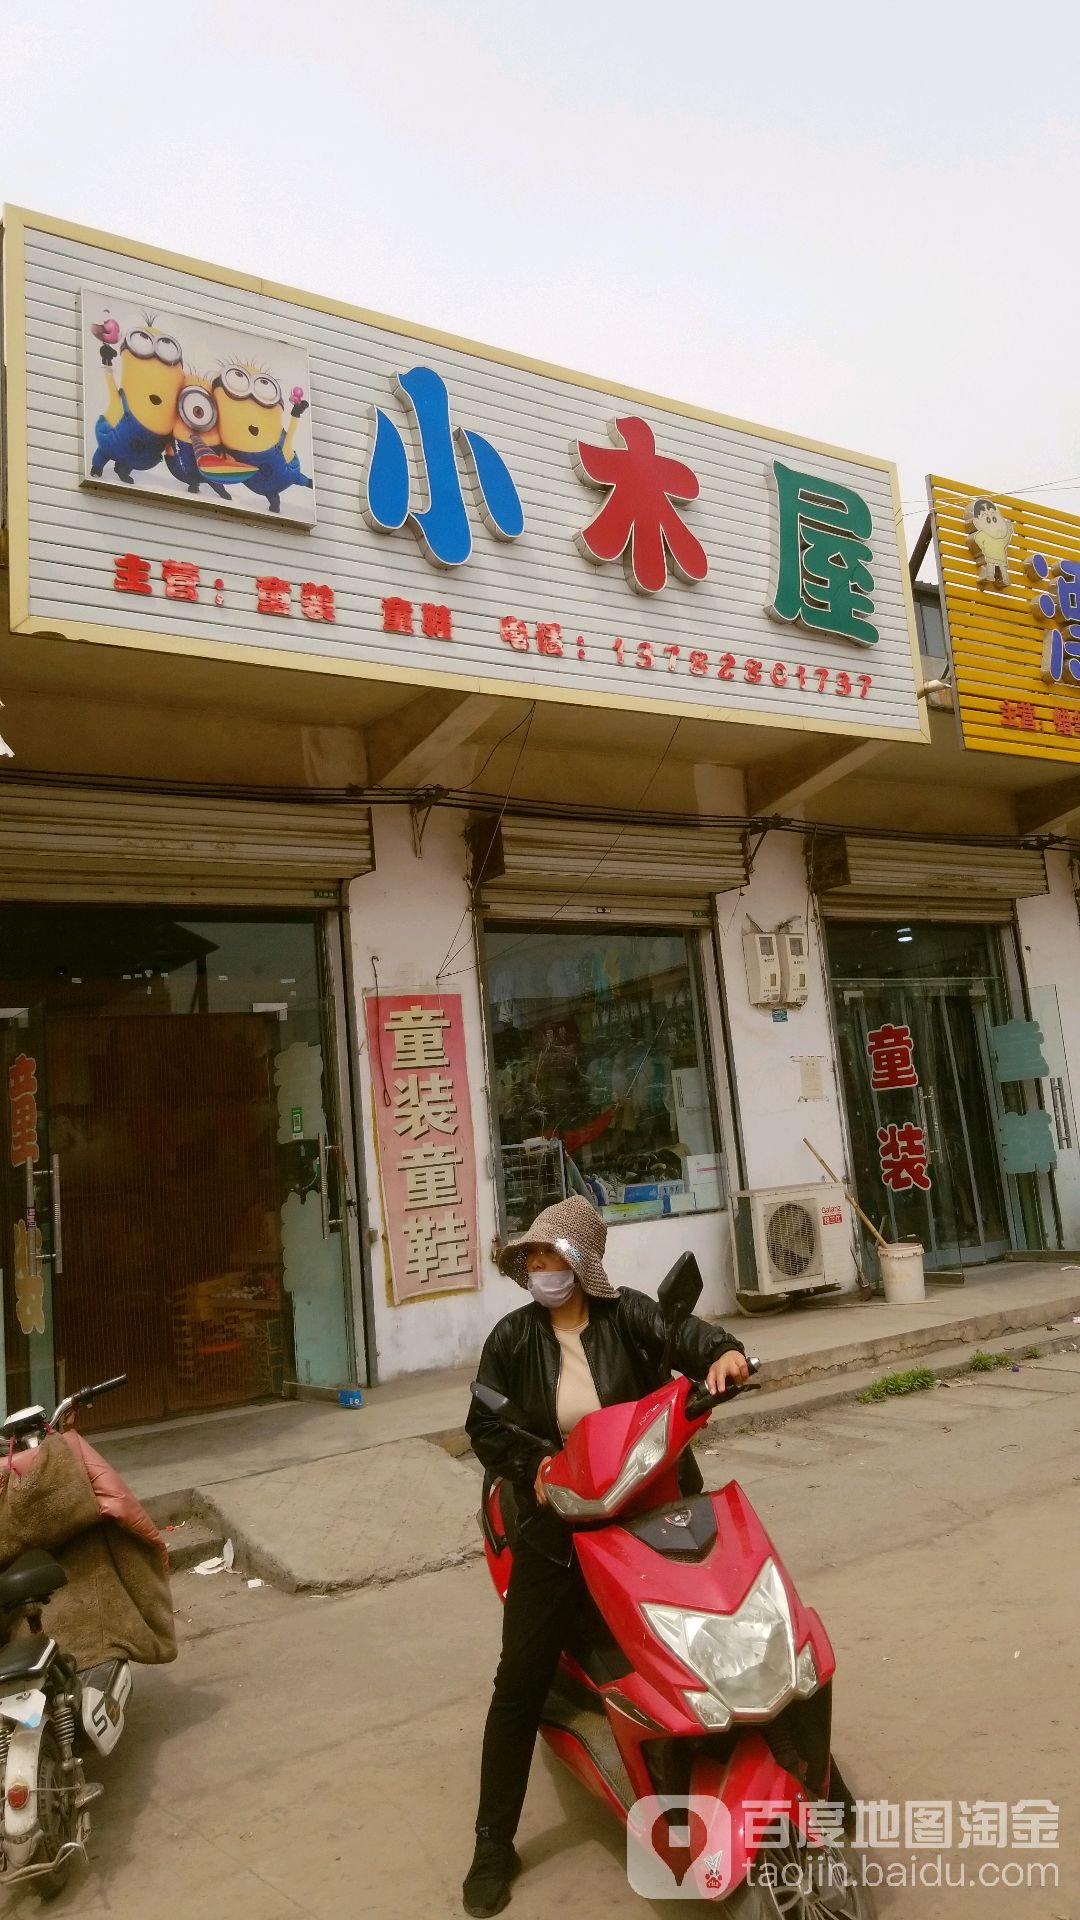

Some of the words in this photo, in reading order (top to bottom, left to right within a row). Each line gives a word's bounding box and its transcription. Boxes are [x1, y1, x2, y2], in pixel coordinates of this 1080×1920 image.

[361, 367, 880, 647] 小木屋
[384, 1005, 474, 1283] 童装童鞋
[867, 1023, 932, 1191] 童装
